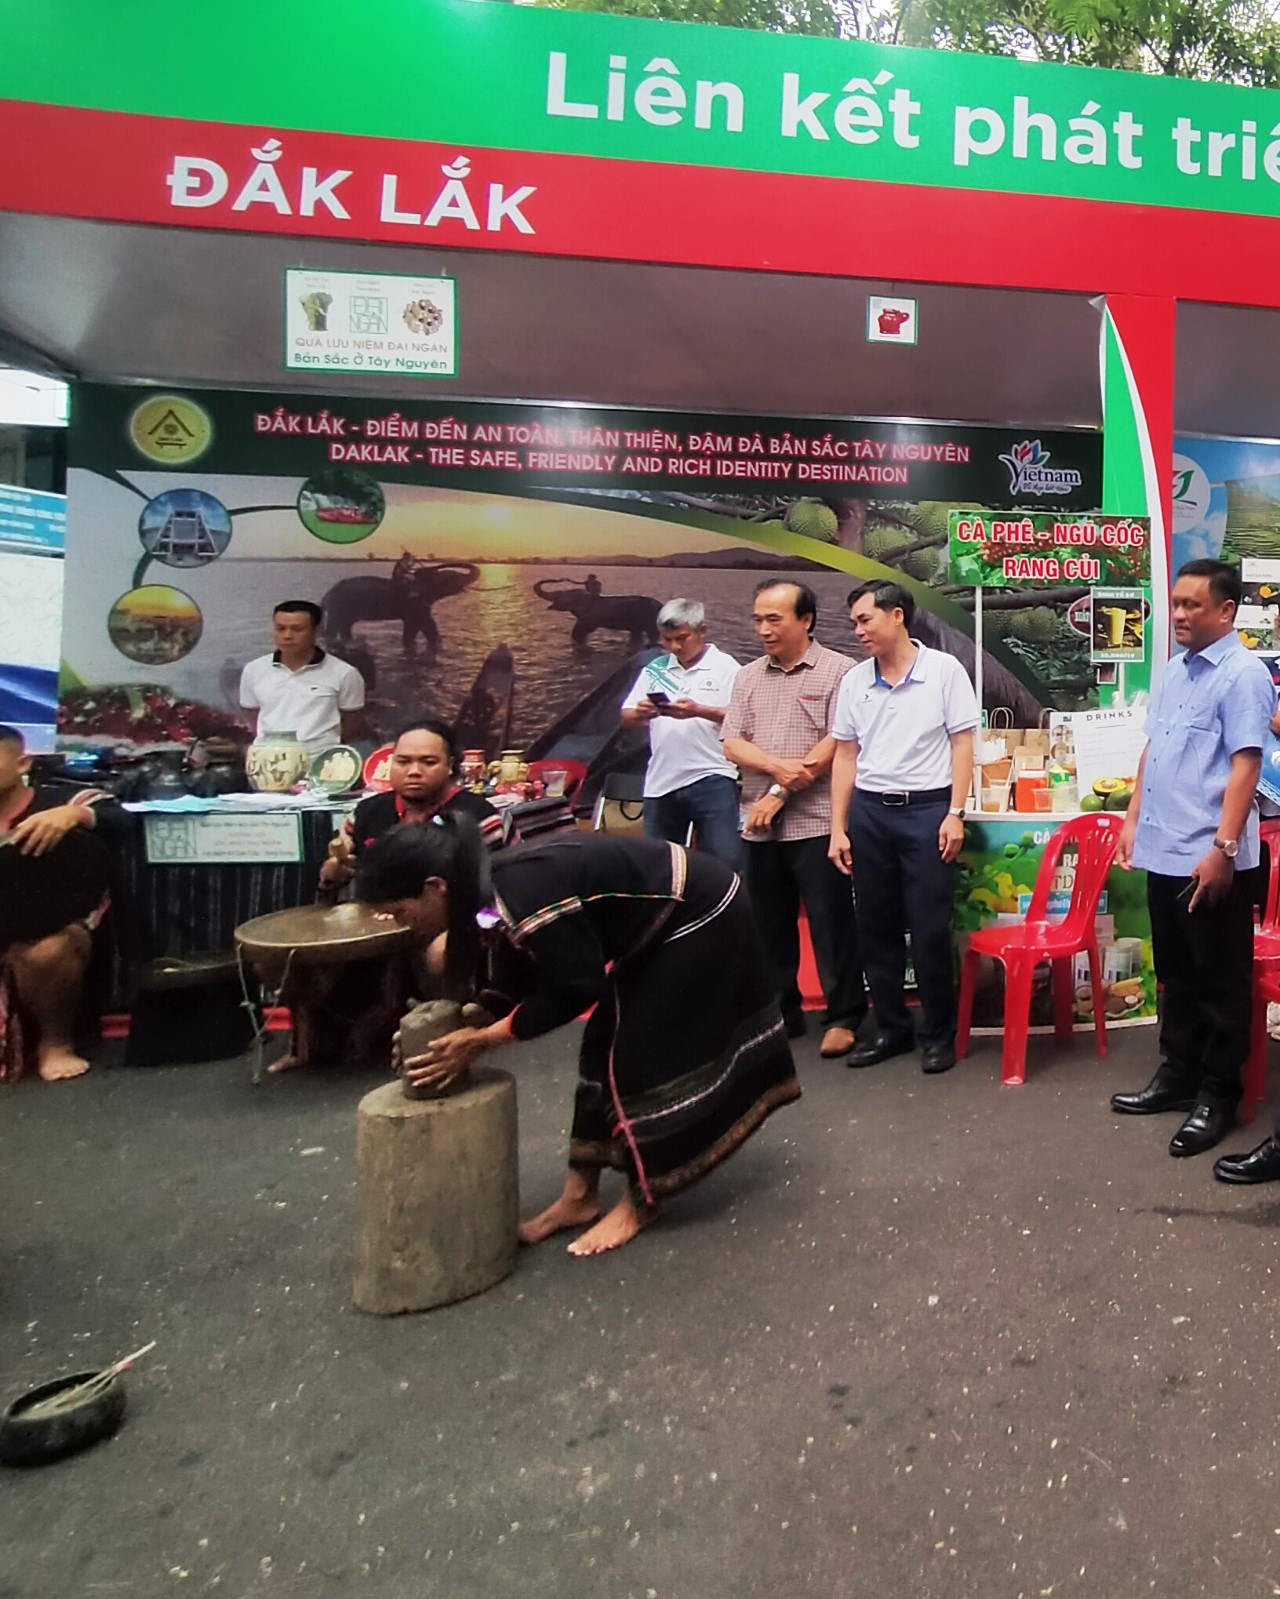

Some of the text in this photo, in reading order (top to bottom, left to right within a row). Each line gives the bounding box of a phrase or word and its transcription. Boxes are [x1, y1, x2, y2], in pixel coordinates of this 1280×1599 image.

[546, 51, 745, 133] Liên
[780, 69, 922, 149] kết
[953, 95, 1144, 170] phát
[166, 137, 538, 235] ĐẮK LẮK
[395, 357, 448, 370] Nguyên
[256, 407, 300, 432] ĐẮK
[307, 409, 346, 435] LẮK
[366, 413, 419, 438] ĐIỂM
[425, 416, 467, 440] ĐẾN
[473, 426, 502, 442] AN
[570, 426, 620, 448] THÂN
[624, 430, 683, 454] THIỆN,
[689, 432, 733, 455] ĐẬM
[738, 433, 764, 454] ĐÀ
[770, 433, 806, 455] BẢN
[811, 434, 849, 457] SẮC
[852, 439, 888, 459] TÂY
[892, 442, 970, 462] NGUYÊN
[331, 443, 410, 463] DAKLAK
[430, 447, 465, 465] THE
[470, 449, 522, 470] SAFE,
[528, 451, 616, 471] FRIENDLY
[622, 456, 662, 473] AND
[668, 458, 711, 475] RICH
[716, 460, 793, 478] IDENTITY
[798, 463, 908, 483] DESTINATION
[998, 454, 1080, 494] Vietnam
[955, 516, 987, 542] CÀ
[991, 517, 1034, 544] PHÊ
[1053, 520, 1097, 545] NGŨ
[1102, 518, 1144, 546] CỐC
[1003, 553, 1100, 580] RANG CỦI
[1086, 710, 1133, 722] DRINKS
